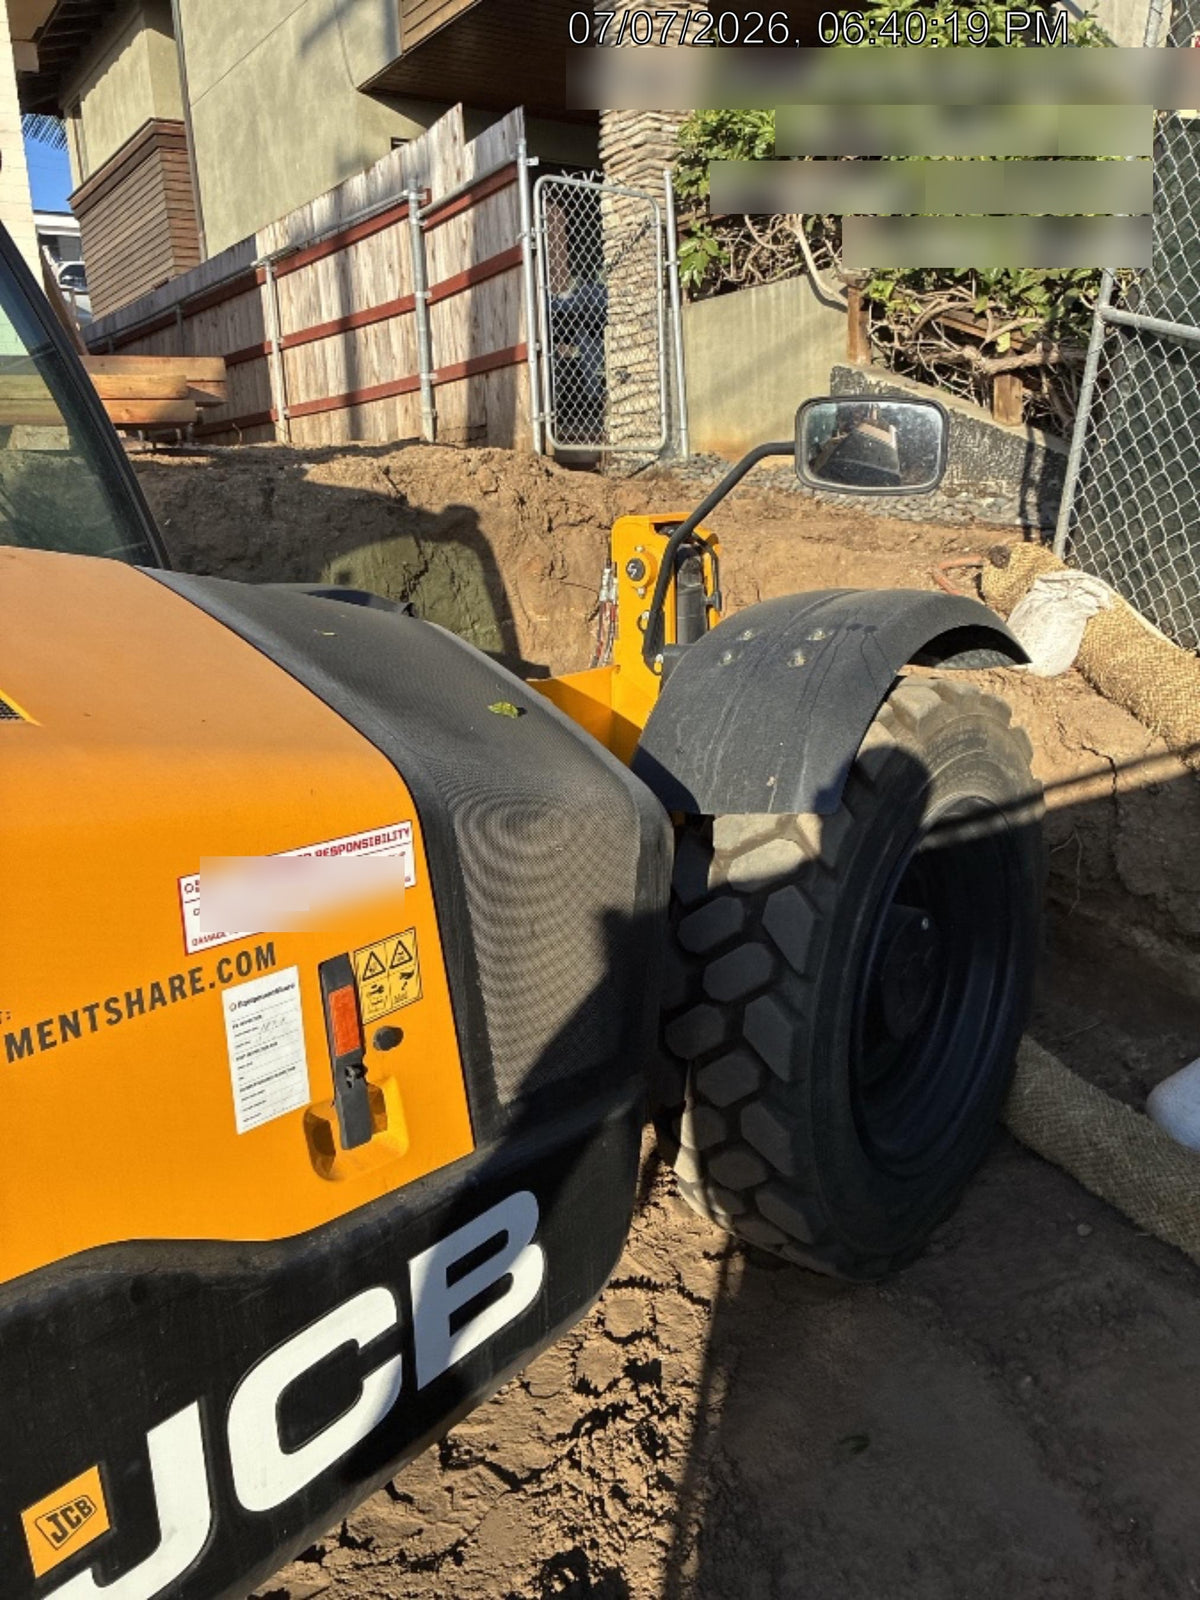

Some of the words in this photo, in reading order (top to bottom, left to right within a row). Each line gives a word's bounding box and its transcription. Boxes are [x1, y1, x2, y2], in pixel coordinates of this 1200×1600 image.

[4, 941, 277, 1064] MENTSHARE.COM
[41, 1190, 545, 1600] JCB
[45, 1499, 93, 1544] JCB
